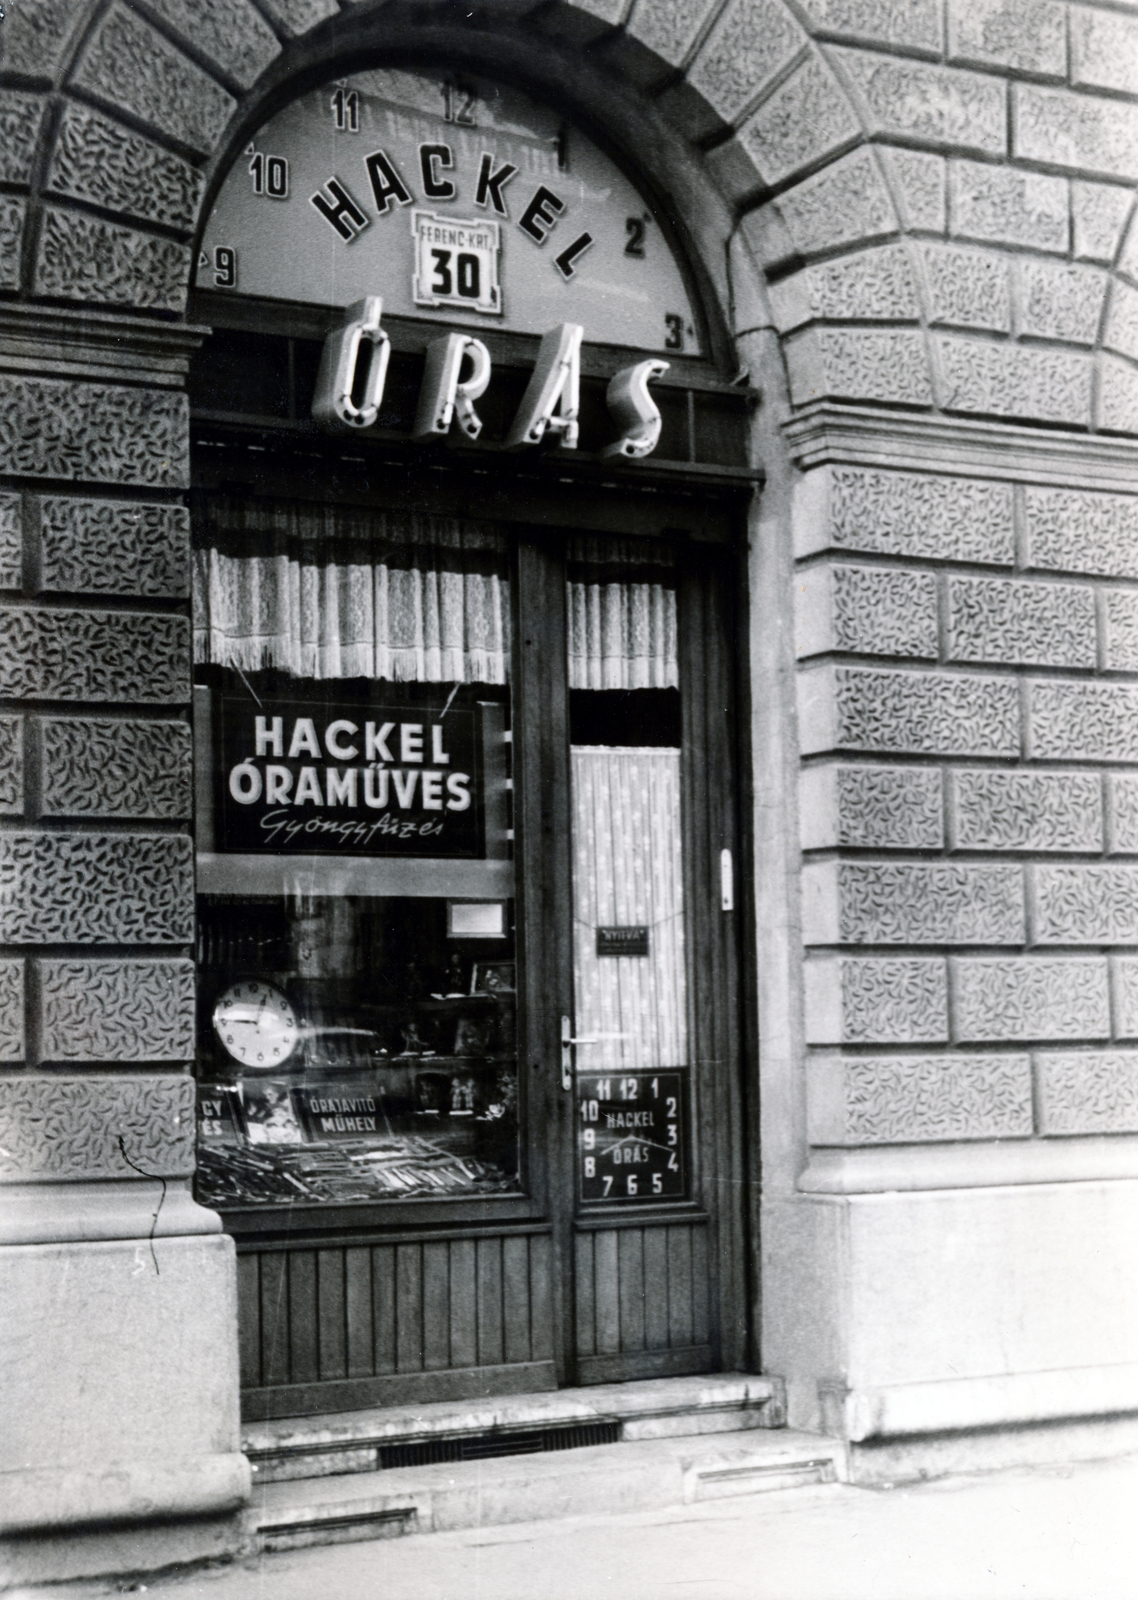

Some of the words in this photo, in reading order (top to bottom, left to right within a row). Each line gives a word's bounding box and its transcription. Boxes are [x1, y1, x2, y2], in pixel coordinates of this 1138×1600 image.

[331, 89, 359, 132] 11
[440, 81, 476, 126] 12
[249, 152, 288, 198] 10
[309, 142, 594, 281] HACKEL
[420, 225, 465, 247] FERENC
[625, 216, 646, 257] 2
[213, 245, 236, 288] 9
[430, 247, 480, 298] 30
[664, 312, 685, 350] 3
[255, 715, 449, 764] HACKEL
[596, 1078, 611, 1100] 11
[619, 1078, 637, 1100] 12
[651, 1077, 659, 1098] 1
[580, 1100, 599, 1122] 10
[666, 1097, 677, 1118] 2
[607, 1111, 655, 1128] HACKEL
[583, 1128, 596, 1150] 9
[667, 1124, 677, 1146] 3
[584, 1156, 596, 1178] 8
[667, 1152, 679, 1172] 4
[602, 1175, 614, 1197] 7
[627, 1174, 638, 1195] 6
[652, 1173, 662, 1194] 5
